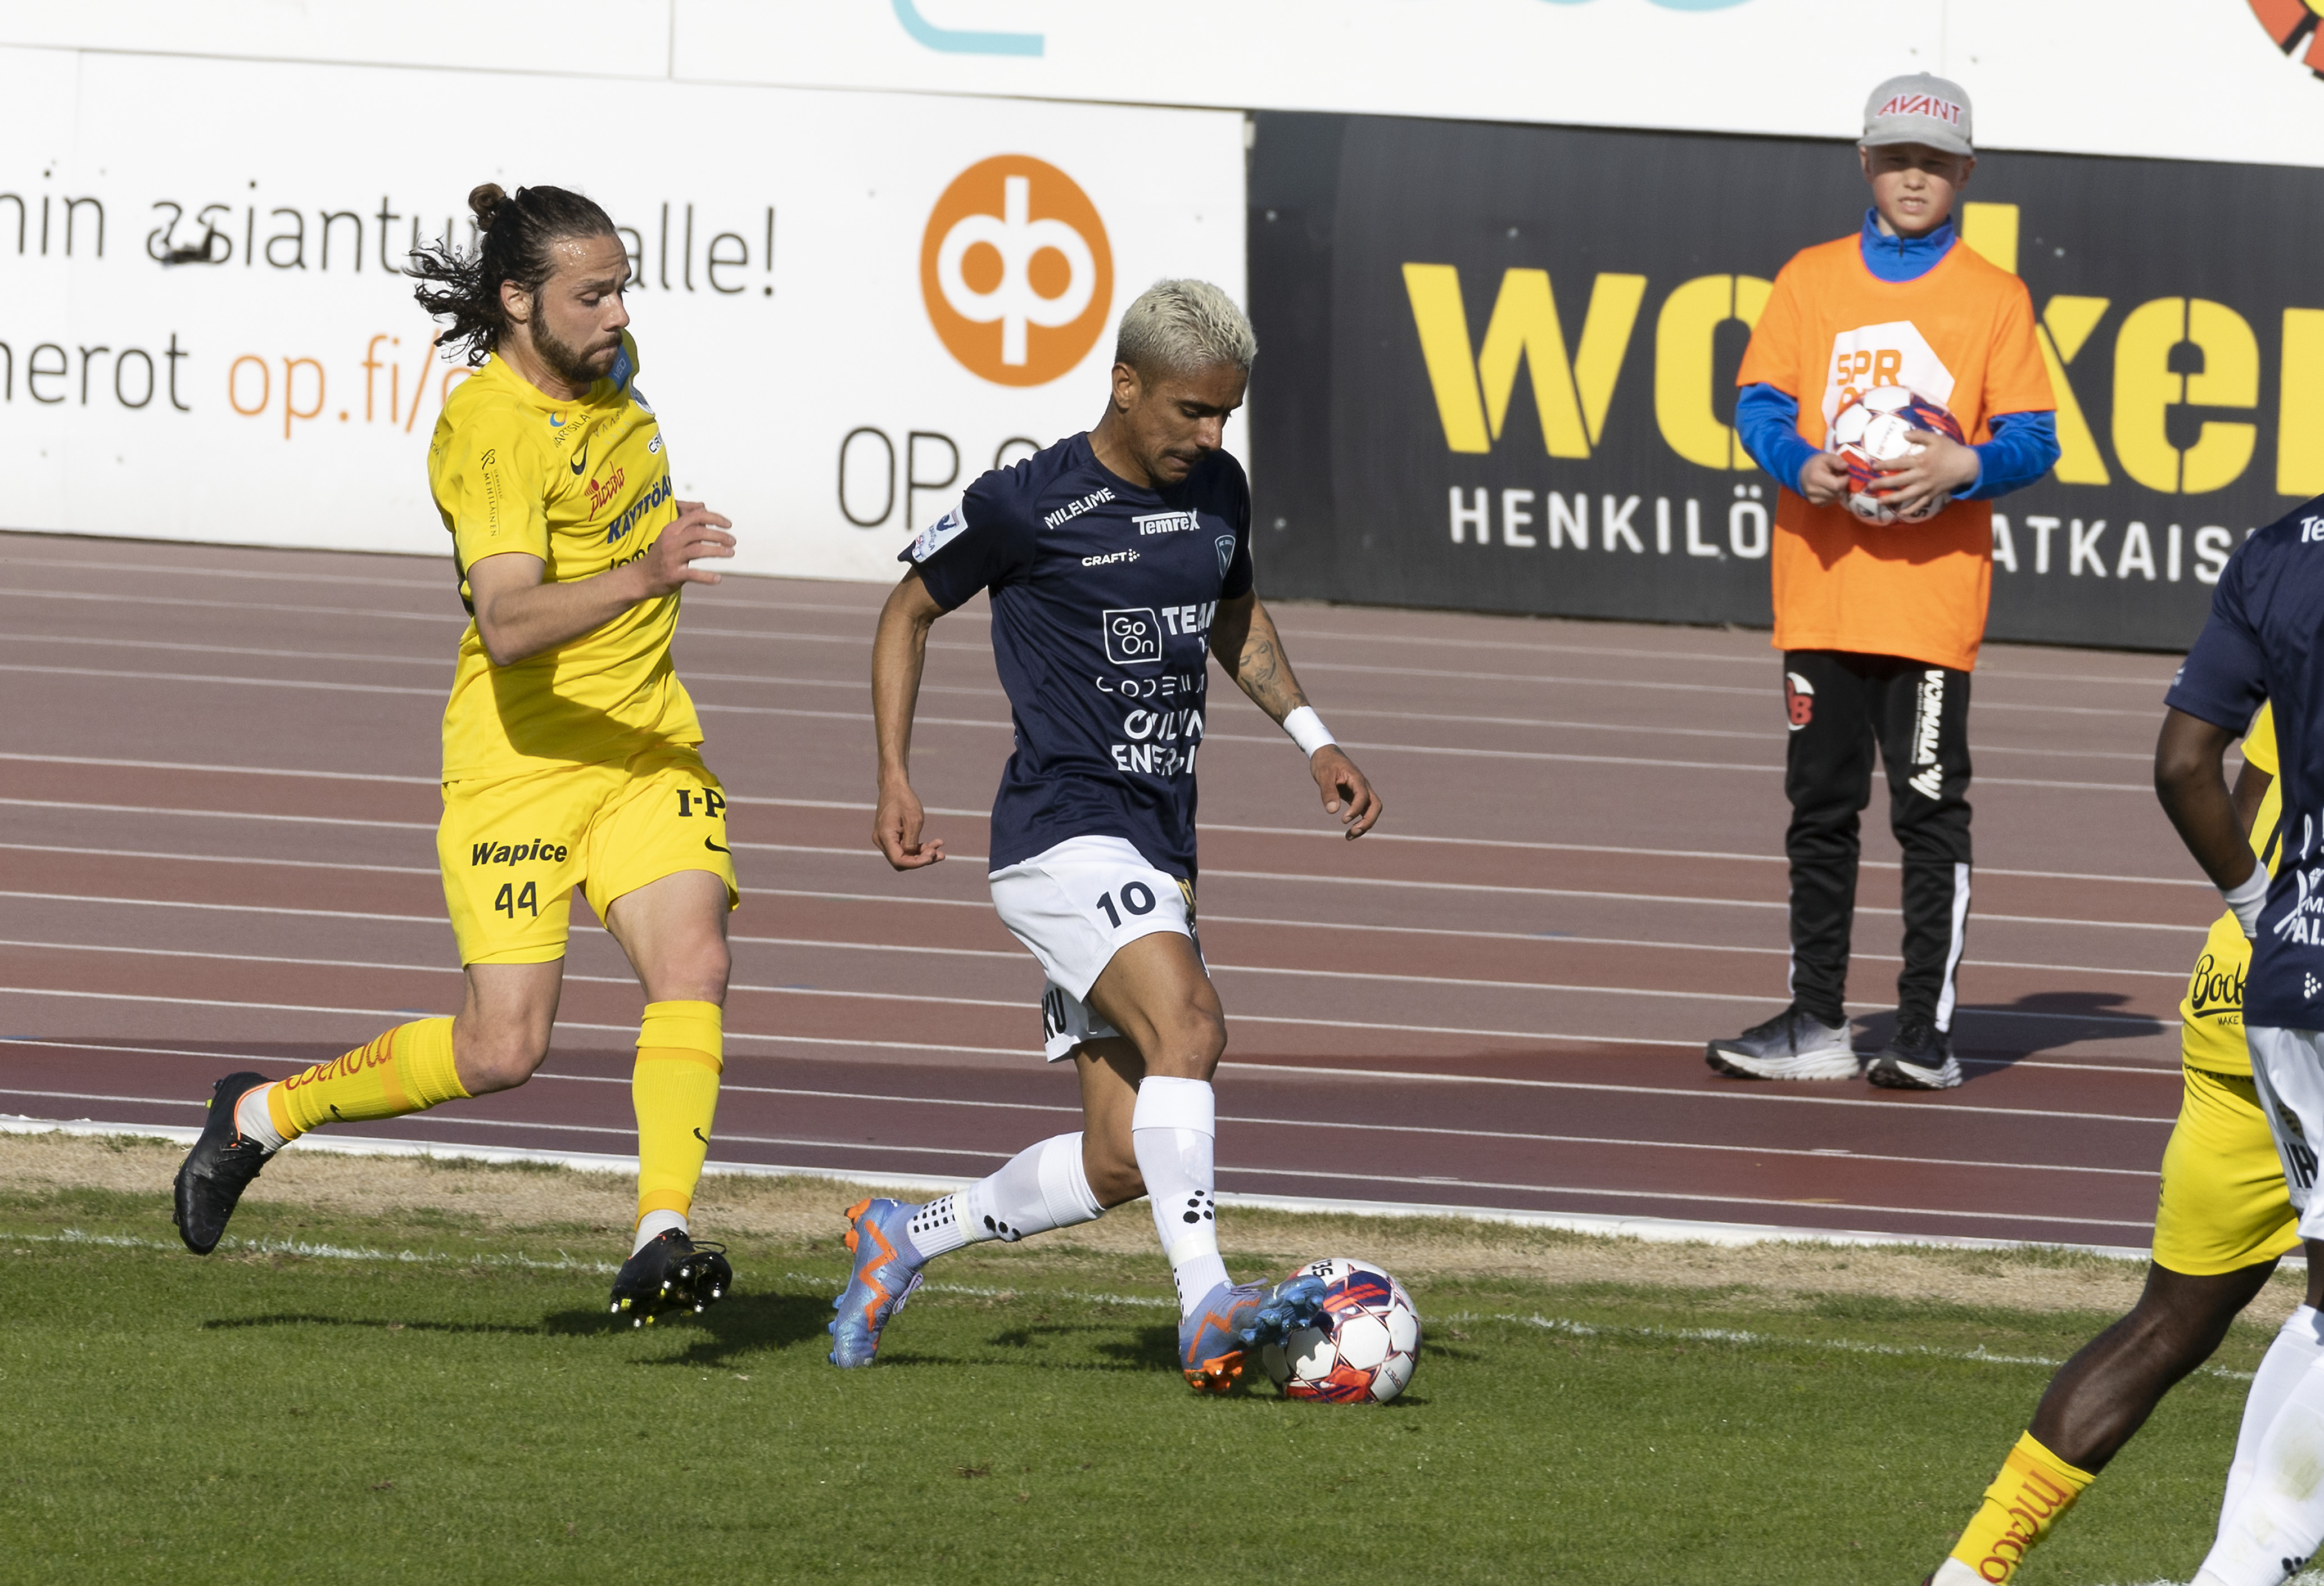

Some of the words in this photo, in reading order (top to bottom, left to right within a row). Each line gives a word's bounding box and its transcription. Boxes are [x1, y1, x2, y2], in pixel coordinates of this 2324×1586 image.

[1875, 94, 1961, 126] AVANT
[1837, 349, 1902, 387] SPR
[838, 426, 960, 531] OP
[607, 475, 671, 544] KÄYTTÖA
[1044, 487, 1115, 530] MILELIME
[1082, 552, 1127, 567] CRAFT
[1112, 617, 1146, 636] Go
[1122, 635, 1154, 654] On
[472, 838, 568, 866] Wapice
[495, 880, 539, 919] 44
[1096, 881, 1156, 929] 10
